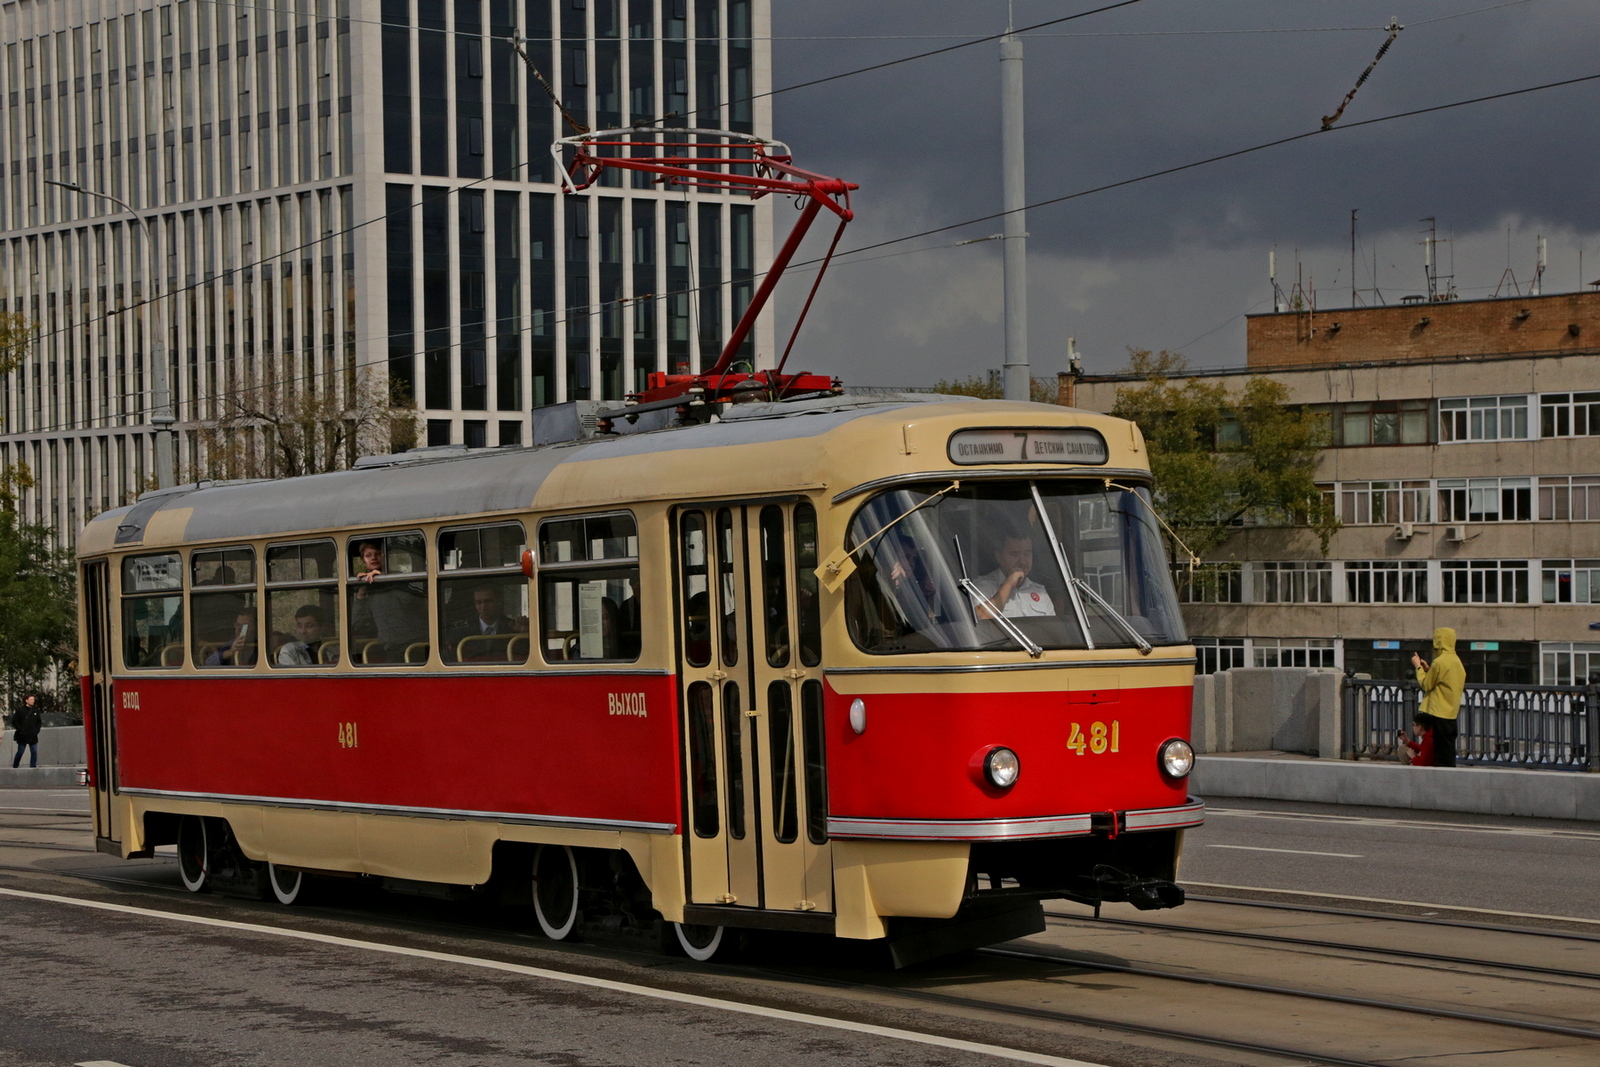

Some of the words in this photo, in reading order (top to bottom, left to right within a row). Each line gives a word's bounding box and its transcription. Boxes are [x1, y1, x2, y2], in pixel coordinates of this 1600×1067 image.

[958, 442, 1004, 456] ОСТАНКИНО
[1013, 433, 1028, 460] 7
[1034, 440, 1065, 455] ДЕТСКИЙ
[122, 691, 140, 711] ВХОД
[608, 692, 647, 718] ВЫХОД
[338, 721, 358, 749] 481
[1066, 719, 1119, 756] 481
